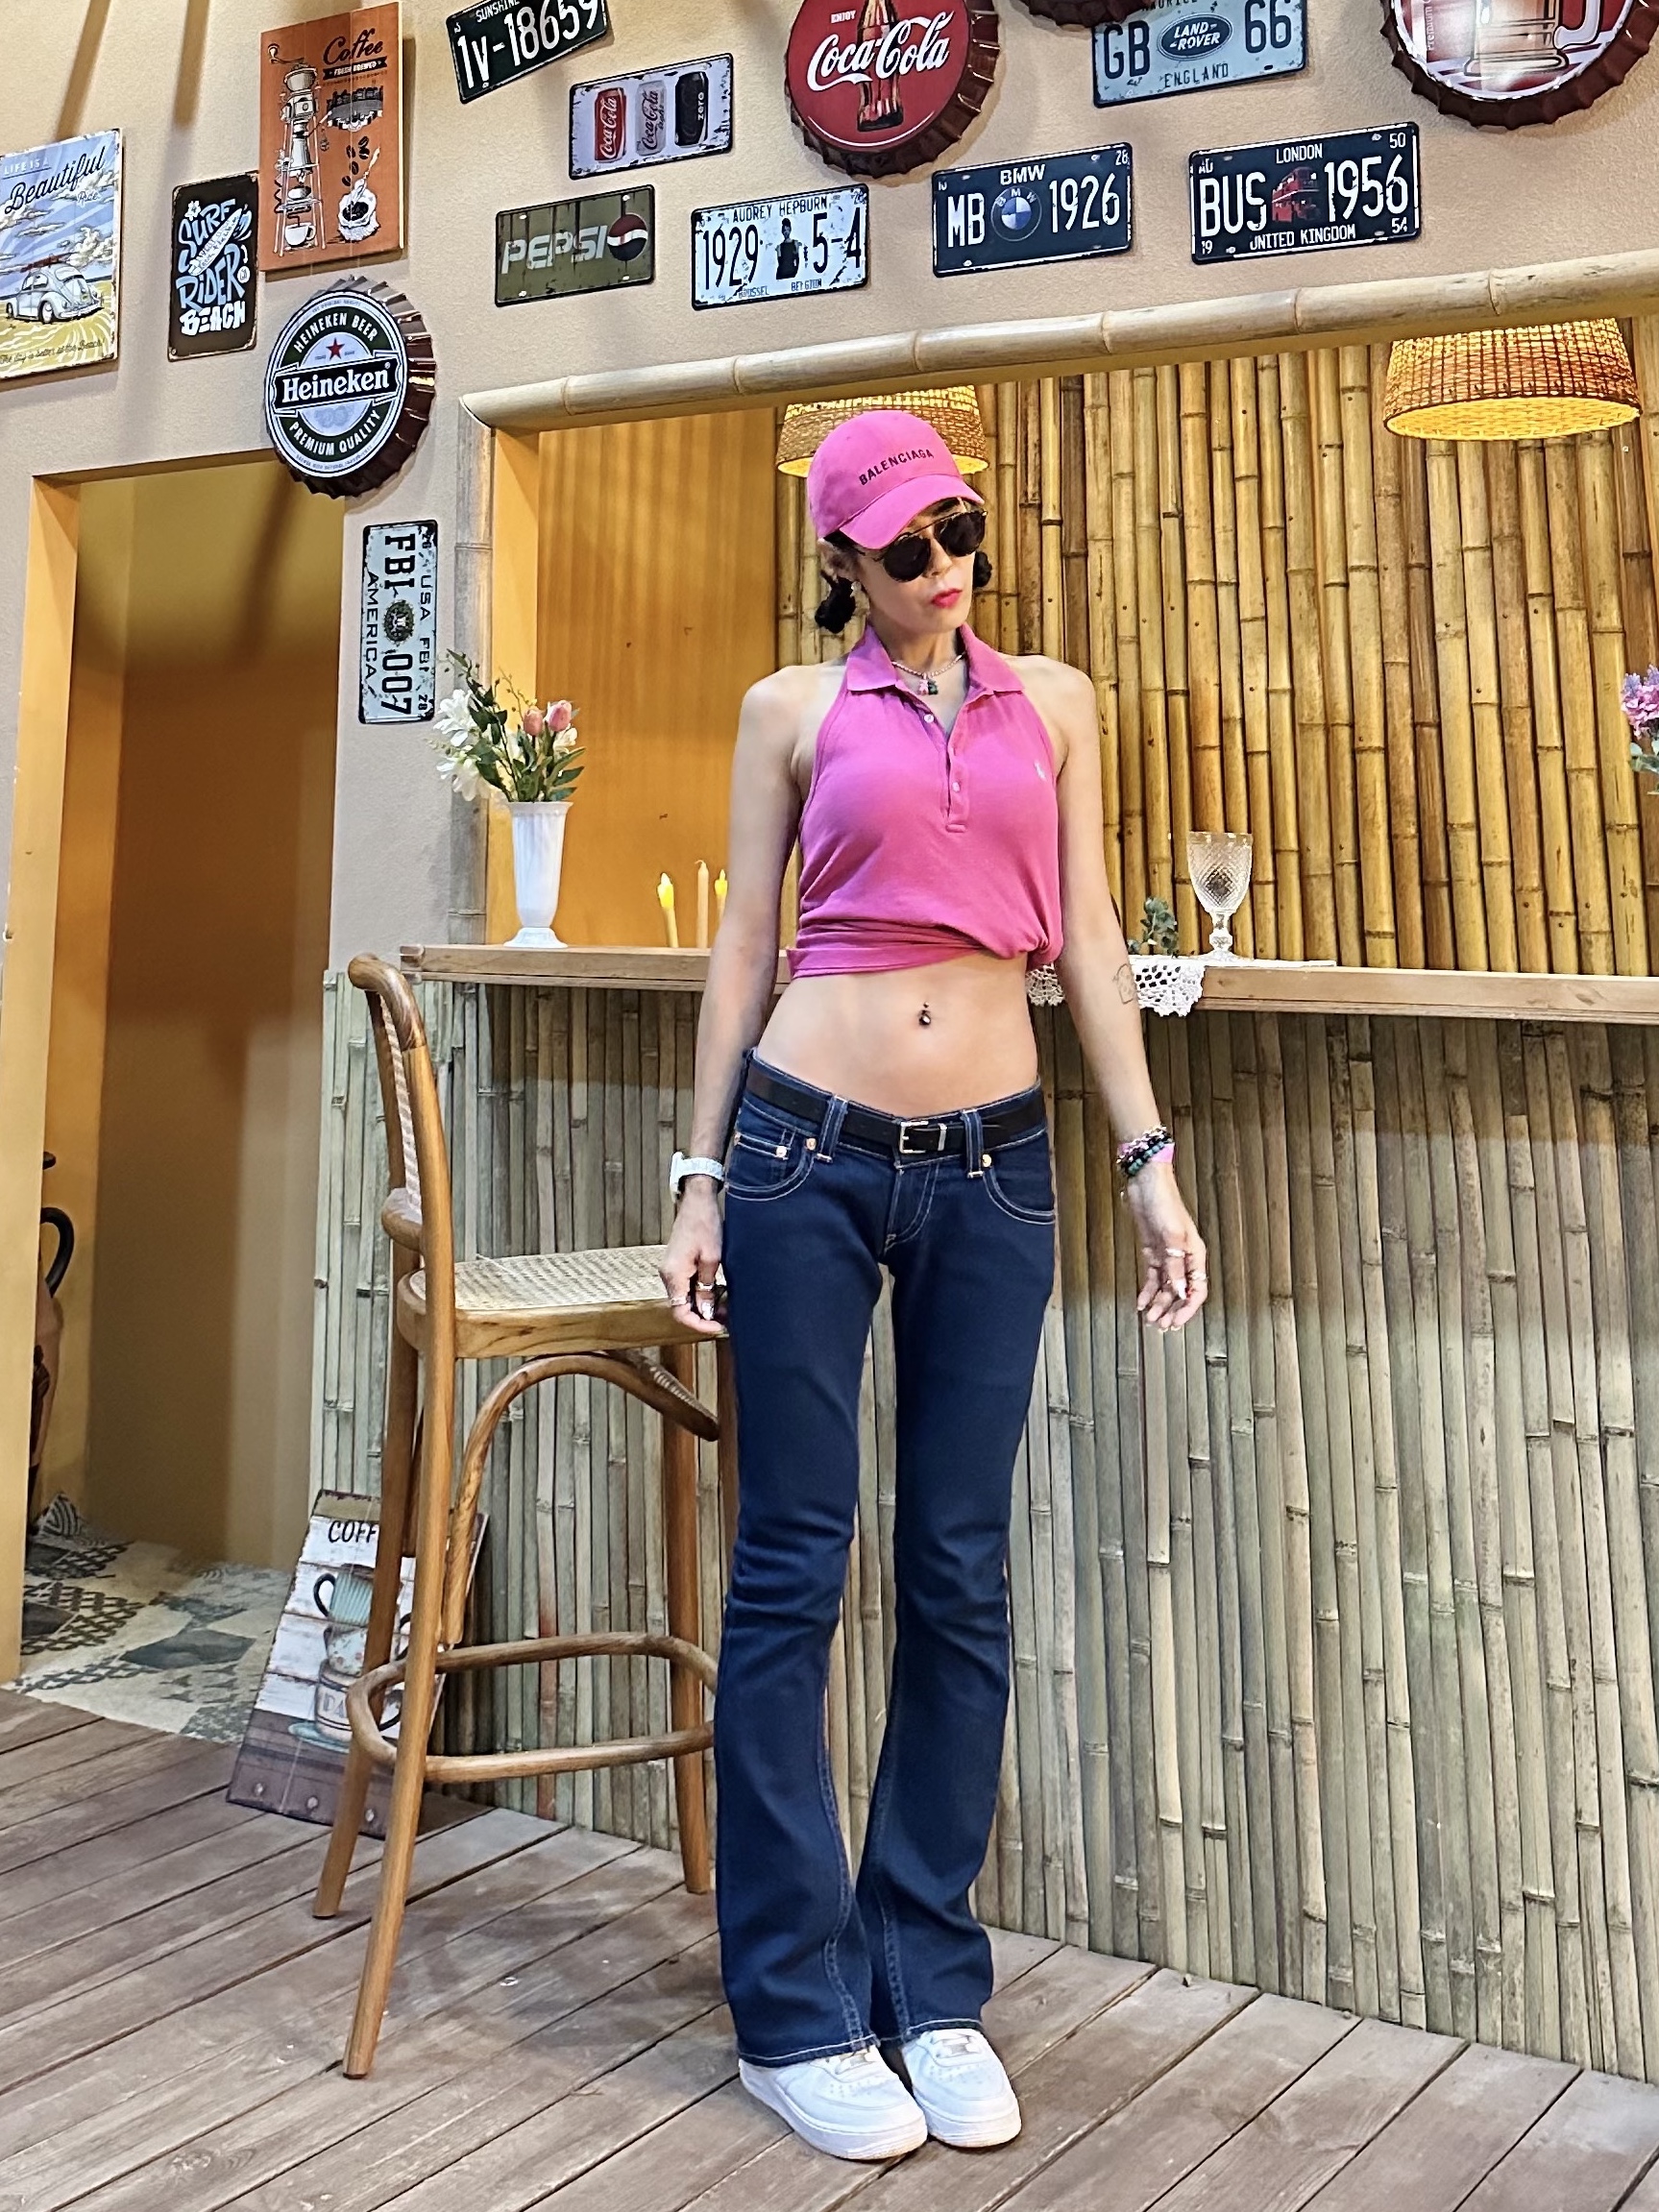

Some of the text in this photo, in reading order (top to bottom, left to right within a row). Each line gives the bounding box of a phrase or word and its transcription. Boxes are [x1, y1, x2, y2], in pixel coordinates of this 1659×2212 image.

[831, 11, 857, 24] ENJOY
[1244, 0, 1292, 54] 66
[323, 27, 384, 65] Coffee
[807, 11, 955, 91] Coca-Cola
[1104, 19, 1151, 80] GB
[1163, 62, 1230, 88] ENGLAND
[1276, 143, 1324, 164] LONDON
[1389, 133, 1406, 149] 50
[4, 161, 27, 175] LIFE
[30, 159, 40, 170] IS
[4, 146, 107, 215] Beautiful
[1000, 164, 1046, 185] BMW
[732, 195, 828, 224] AUDREY HEPBURN
[947, 173, 1120, 248] MB 1926
[1200, 154, 1409, 238] BUS 1956
[1250, 224, 1356, 252] UNITED KINGDOM
[1391, 217, 1408, 233] 54
[500, 225, 608, 275] PEPSI
[702, 224, 759, 291] 1929
[180, 300, 246, 336] BEACH
[293, 312, 378, 353] HEINEKEN BEER
[281, 368, 390, 403] Heineken
[289, 409, 381, 456] PREMIUM QUALITY
[858, 449, 935, 486] BALENCIAGA
[420, 574, 432, 621] USA
[365, 571, 379, 680] AMERICA
[380, 533, 416, 715] FBI 007
